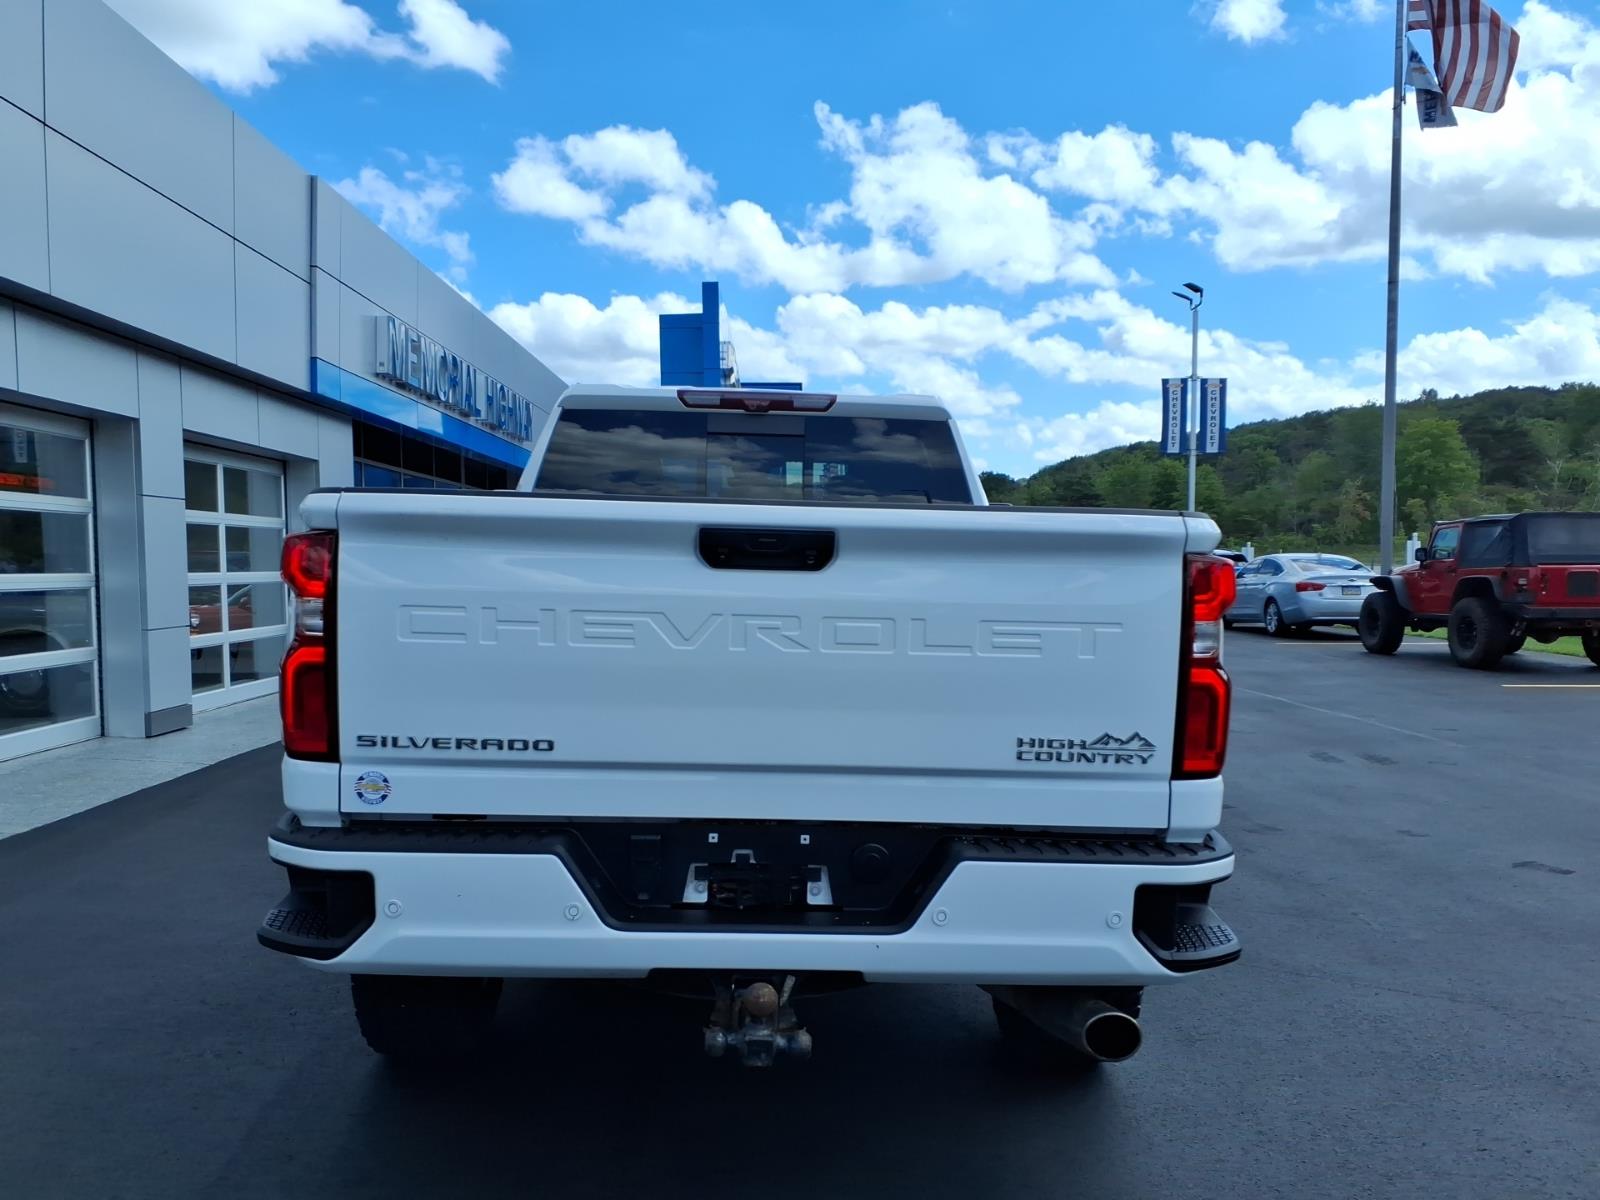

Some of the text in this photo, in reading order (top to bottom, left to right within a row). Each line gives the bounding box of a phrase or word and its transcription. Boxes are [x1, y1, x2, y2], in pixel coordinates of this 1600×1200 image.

[388, 316, 481, 418] MEMORIAL
[1209, 389, 1217, 448] CHEVROLET
[397, 604, 1124, 659] CHEVROLET
[356, 735, 555, 752] SILVERADO
[1016, 737, 1088, 750] HIGH
[1016, 750, 1154, 765] COUNTRY
